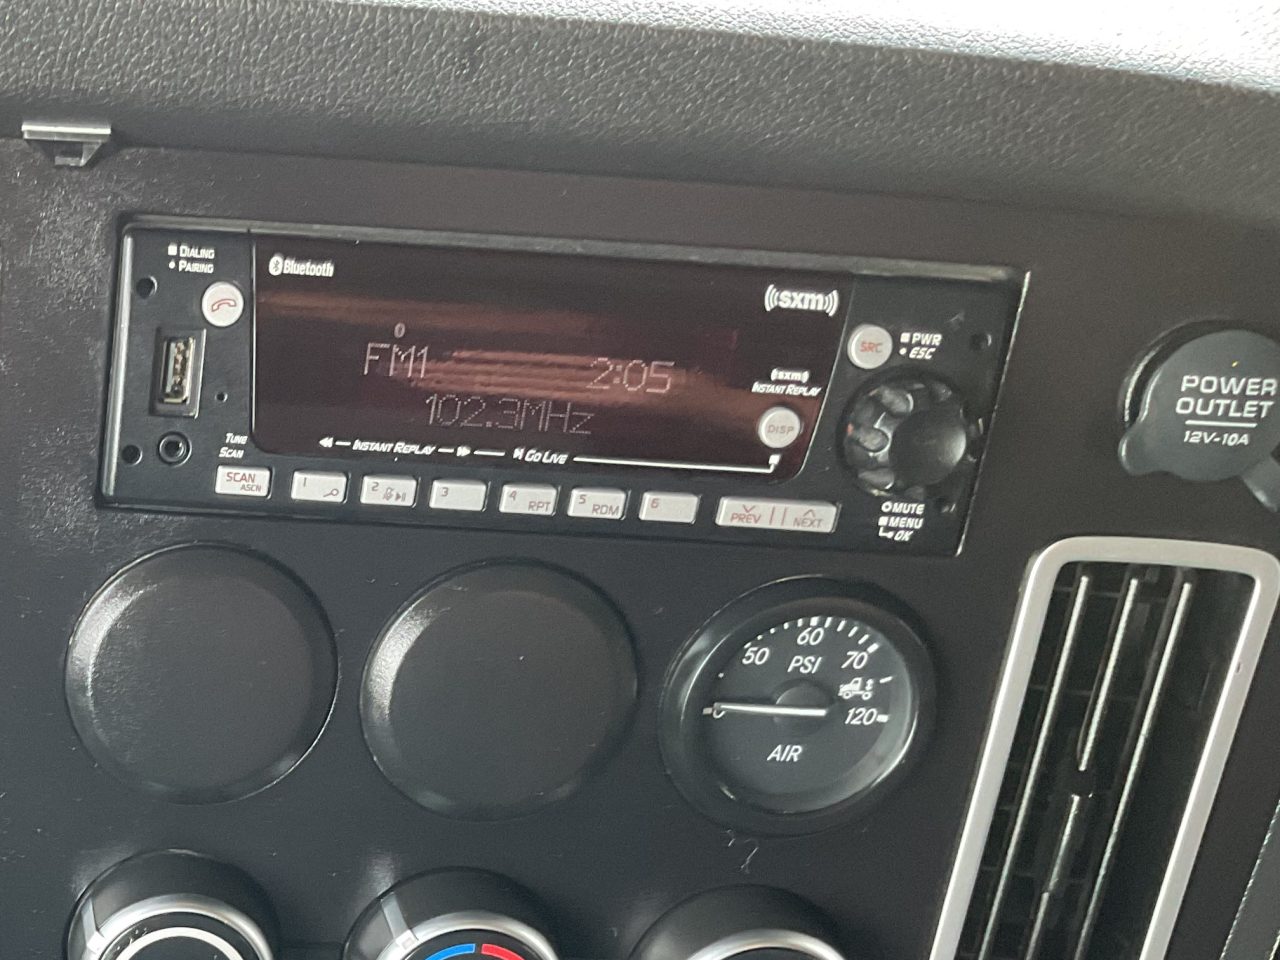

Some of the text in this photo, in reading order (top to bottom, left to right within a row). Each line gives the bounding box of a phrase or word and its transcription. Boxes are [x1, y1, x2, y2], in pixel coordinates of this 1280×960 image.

[283, 258, 335, 277] Bluetooth
[911, 333, 942, 346] PWR
[860, 341, 883, 353] SRC
[908, 347, 935, 360] ESC
[364, 342, 429, 378] FM1
[586, 357, 675, 394] 2:05
[751, 381, 822, 397] INSTANT REPLAY
[1180, 375, 1278, 396] POWER
[426, 393, 595, 435] 102.3MHz
[1175, 397, 1275, 418] OUTLET
[767, 425, 795, 435] DISP
[1183, 430, 1250, 446] 12V-10A
[226, 472, 256, 484] SCAN
[371, 482, 380, 492] 2
[440, 487, 449, 497] 3
[508, 491, 518, 501] 4
[579, 495, 587, 505] 5
[527, 501, 551, 513] RPT
[592, 504, 620, 516] RDM
[650, 498, 660, 509] 6
[892, 502, 925, 515] MUTE
[730, 513, 762, 525] PREV
[793, 517, 824, 528] NEXT
[888, 516, 924, 529] MENU
[894, 529, 914, 542] OK
[796, 628, 824, 646] 60
[742, 647, 770, 665] 50
[841, 651, 869, 670] 70
[787, 655, 822, 674] PSI
[844, 708, 877, 725] 120
[766, 744, 803, 762] AIR
